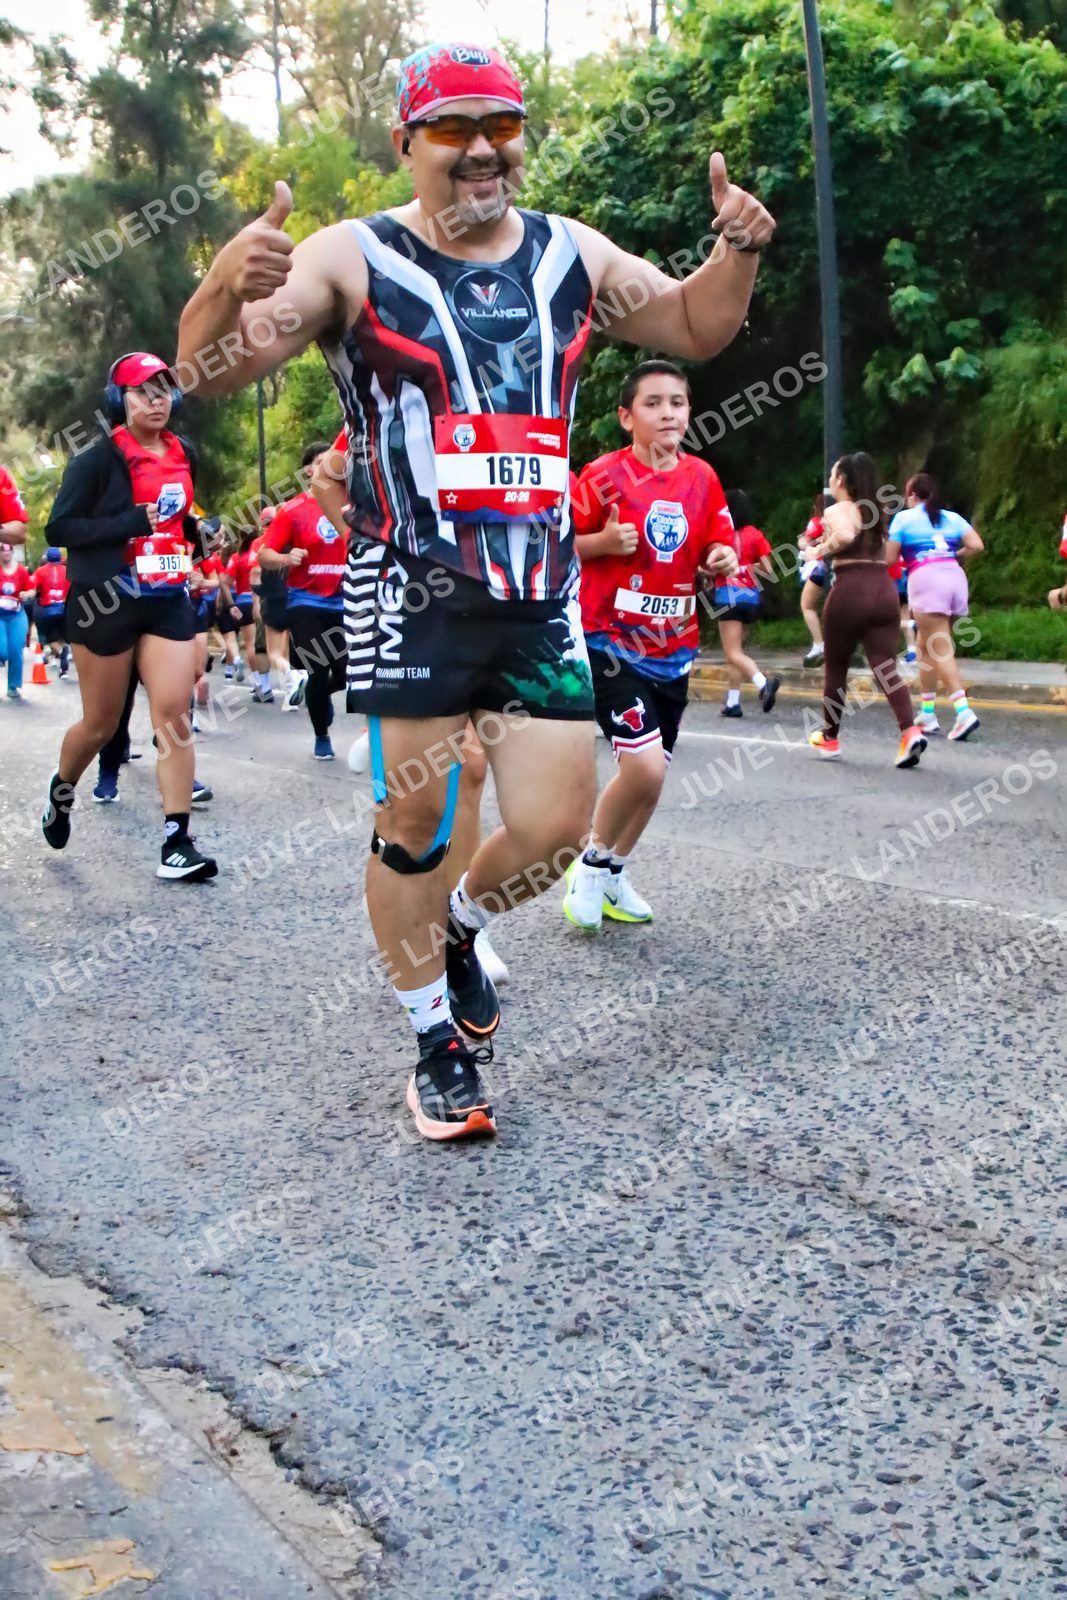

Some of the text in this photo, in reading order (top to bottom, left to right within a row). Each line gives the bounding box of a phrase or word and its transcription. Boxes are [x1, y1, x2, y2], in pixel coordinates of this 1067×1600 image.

[456, 47, 489, 64] Buff
[486, 456, 542, 485] 1679
[640, 595, 679, 615] 2053
[375, 667, 430, 679] RUNNING TEAM
